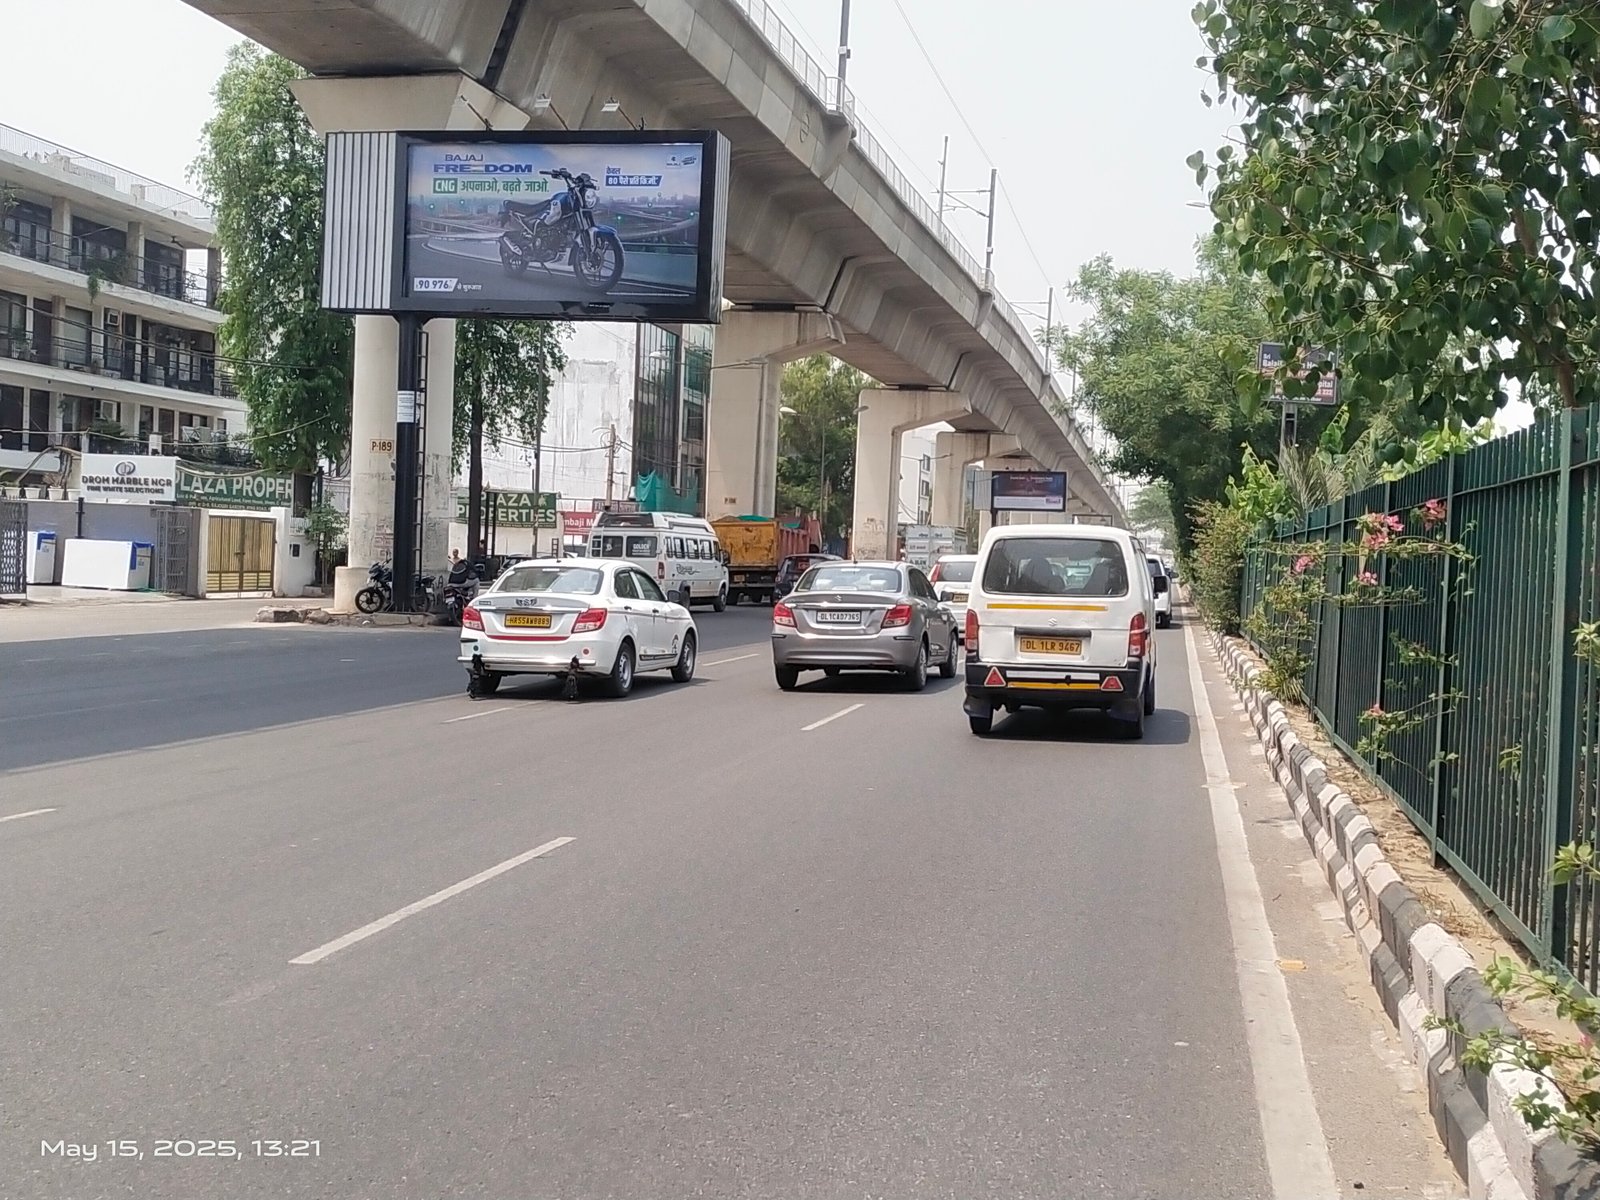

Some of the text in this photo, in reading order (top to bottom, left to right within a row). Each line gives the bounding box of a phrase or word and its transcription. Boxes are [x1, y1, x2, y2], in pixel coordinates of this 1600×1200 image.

[434, 179, 456, 192] CNG
[460, 178, 500, 193] अपनाओ,
[502, 178, 522, 194] बढ़ते
[608, 177, 618, 185] 80
[82, 476, 172, 487] DROM MARBLE NCR
[1026, 641, 1080, 652] DL 1LR 9467
